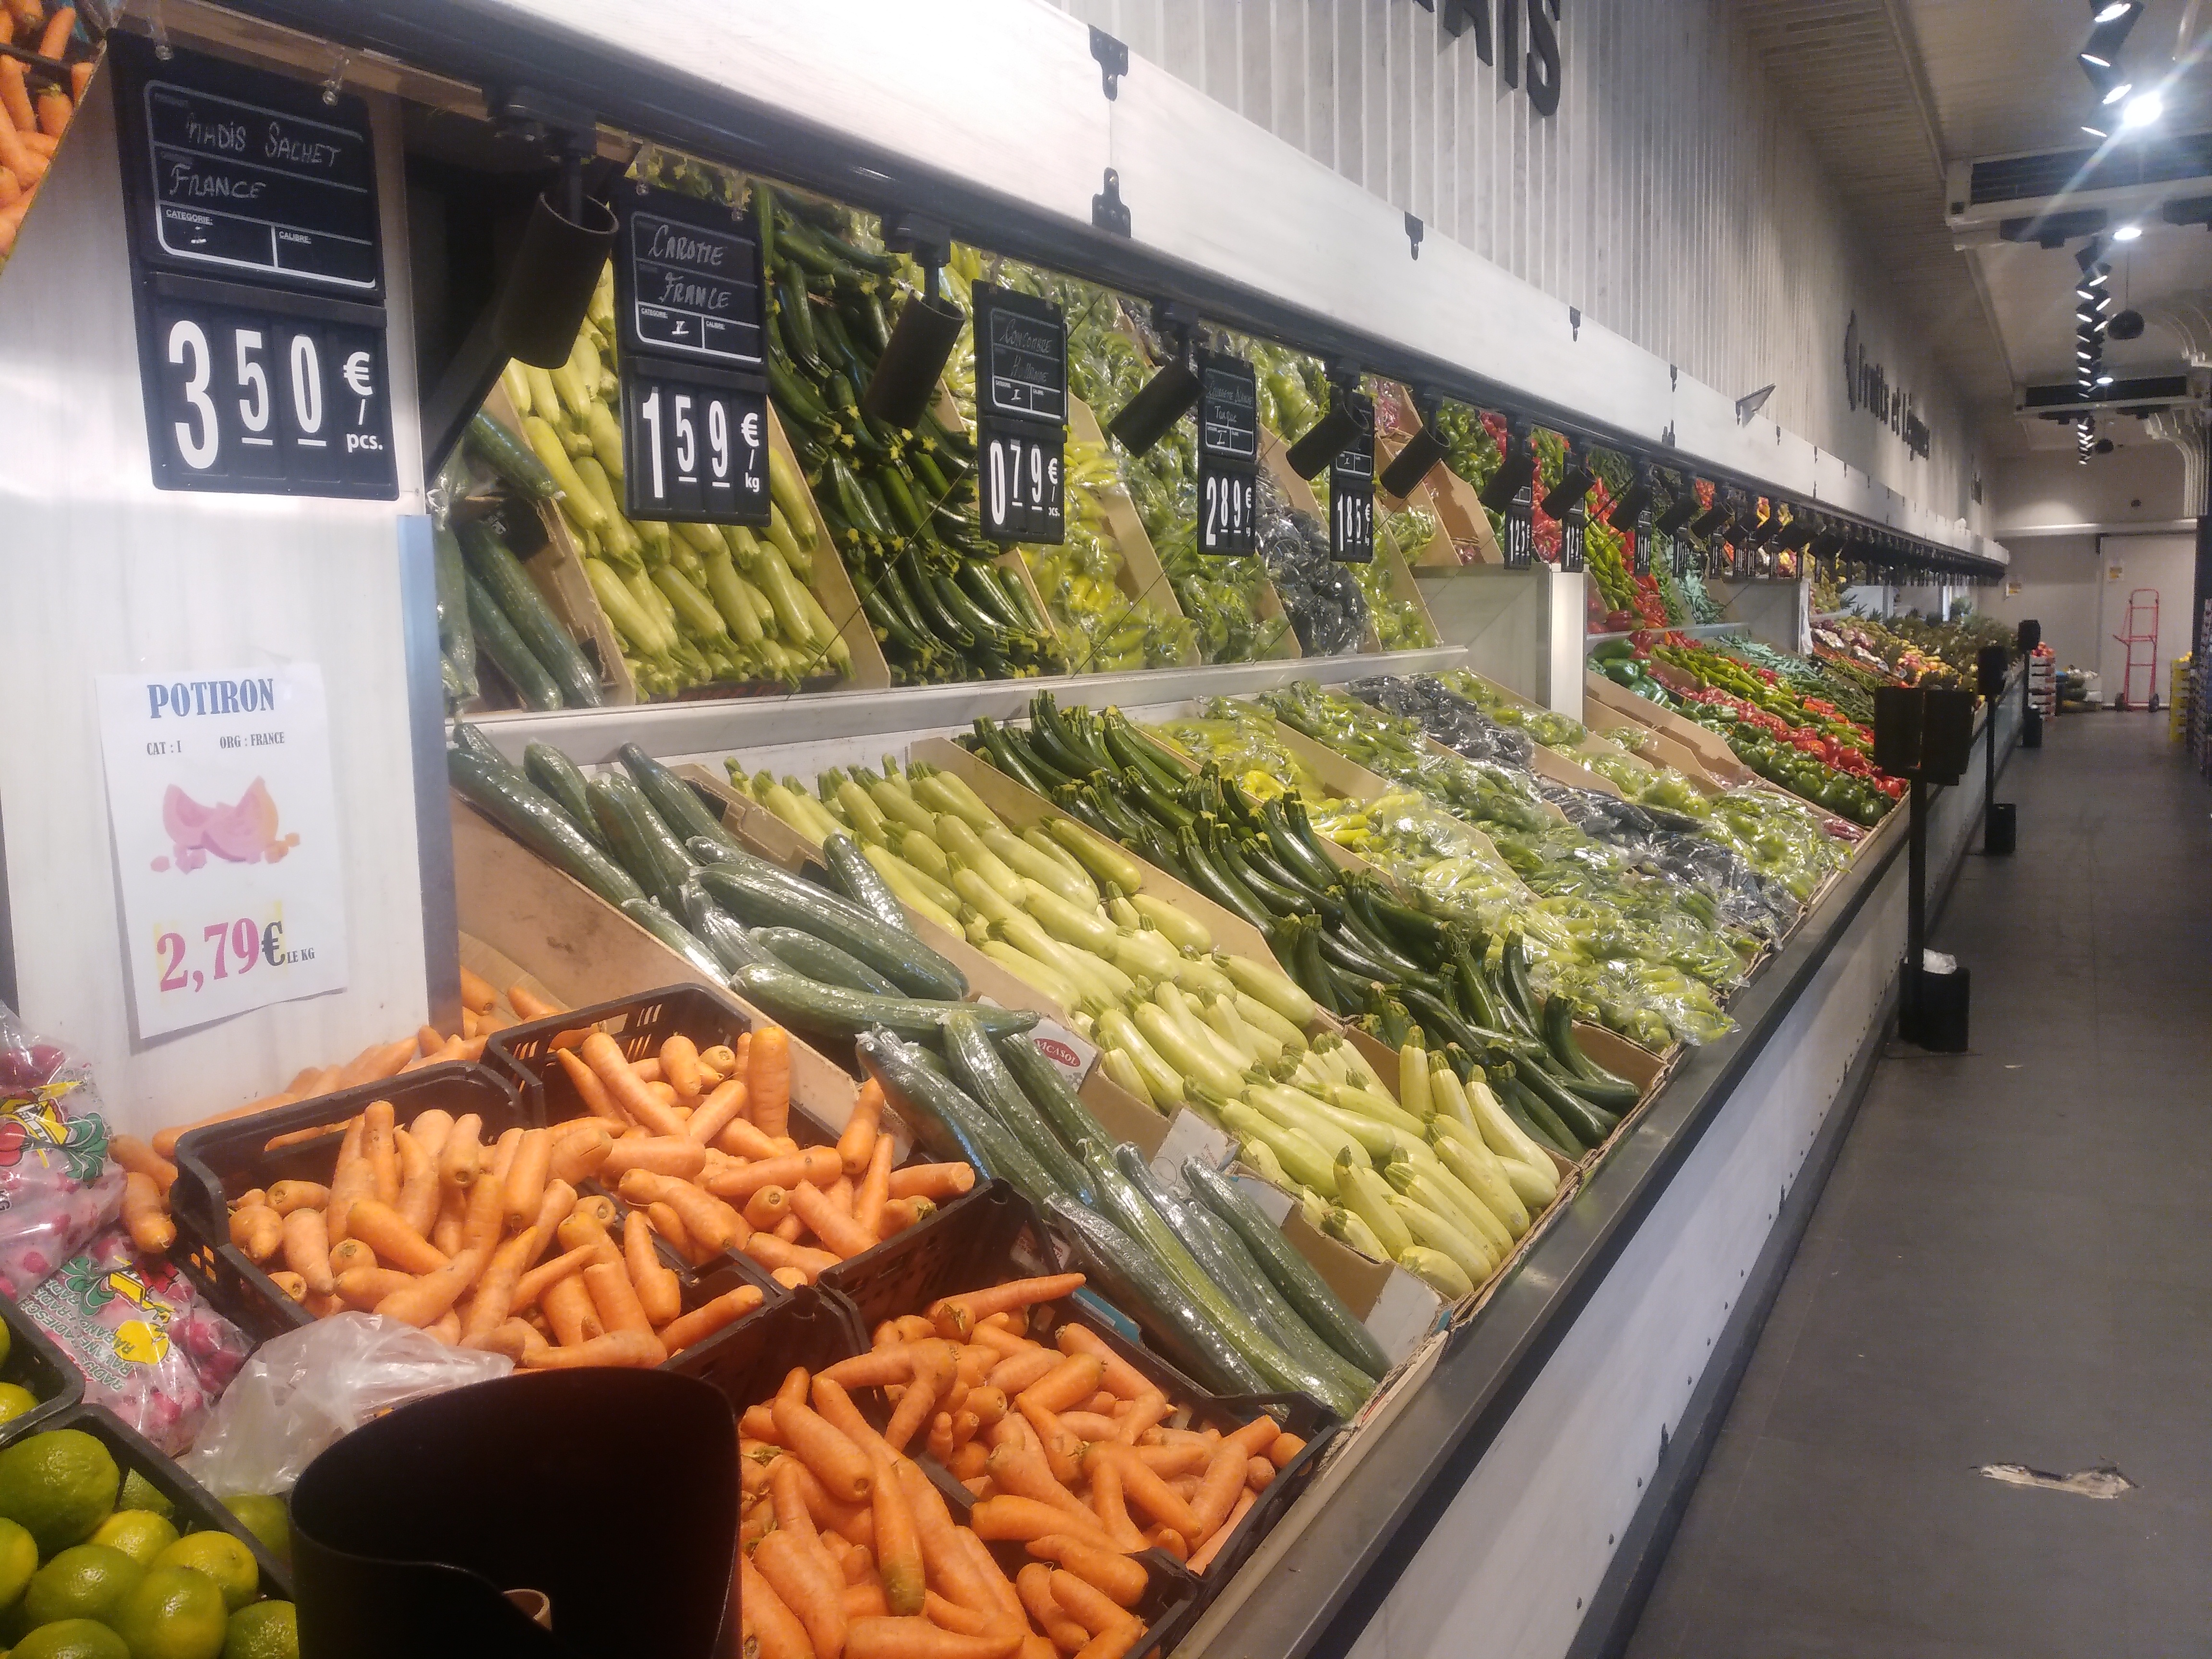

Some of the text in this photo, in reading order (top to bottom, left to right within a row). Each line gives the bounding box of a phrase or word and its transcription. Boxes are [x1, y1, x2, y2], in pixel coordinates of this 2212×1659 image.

[346, 432, 383, 454] pcs.
[745, 472, 760, 493] kg
[147, 677, 276, 719] POTIRON
[146, 741, 166, 756] CAT
[219, 735, 241, 749] ORG
[250, 731, 285, 746] FRANCE
[287, 950, 299, 964] LE
[301, 946, 316, 961] KG
